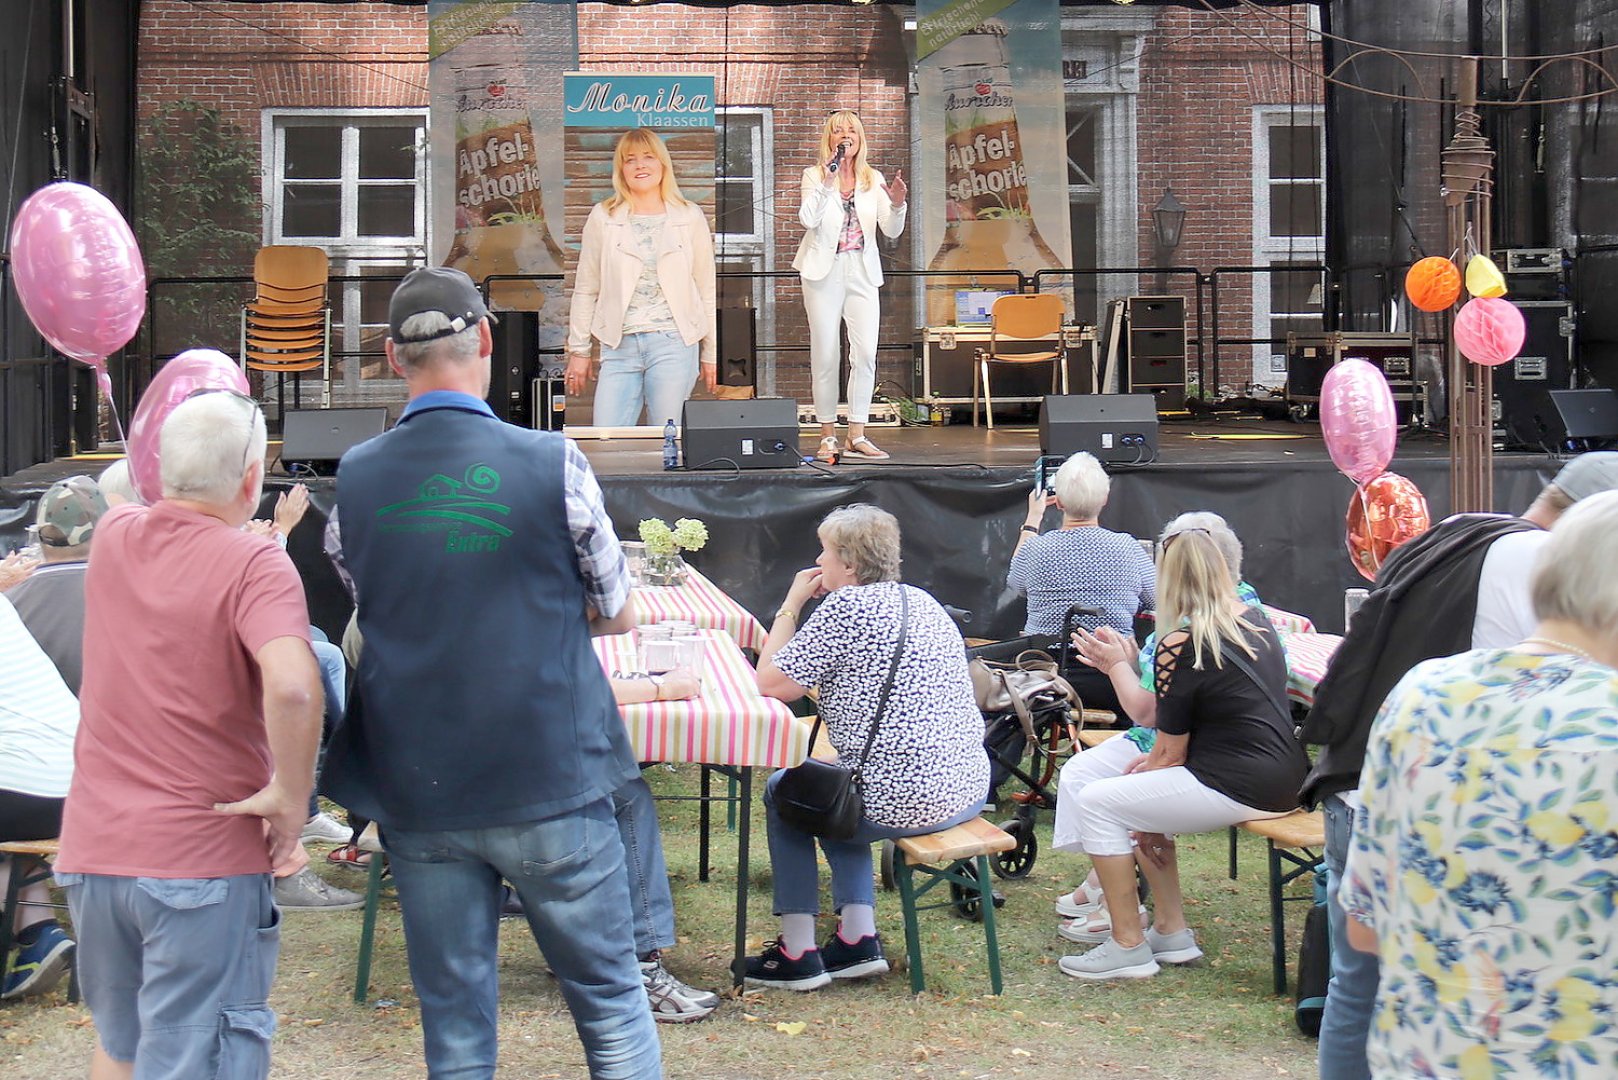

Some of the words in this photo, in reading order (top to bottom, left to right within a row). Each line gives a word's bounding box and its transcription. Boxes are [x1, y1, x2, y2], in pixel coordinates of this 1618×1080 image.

[567, 82, 713, 112] Monika
[636, 112, 709, 127] Klaassen
[459, 132, 529, 179] Apfel-
[949, 129, 1015, 174] Apfel-
